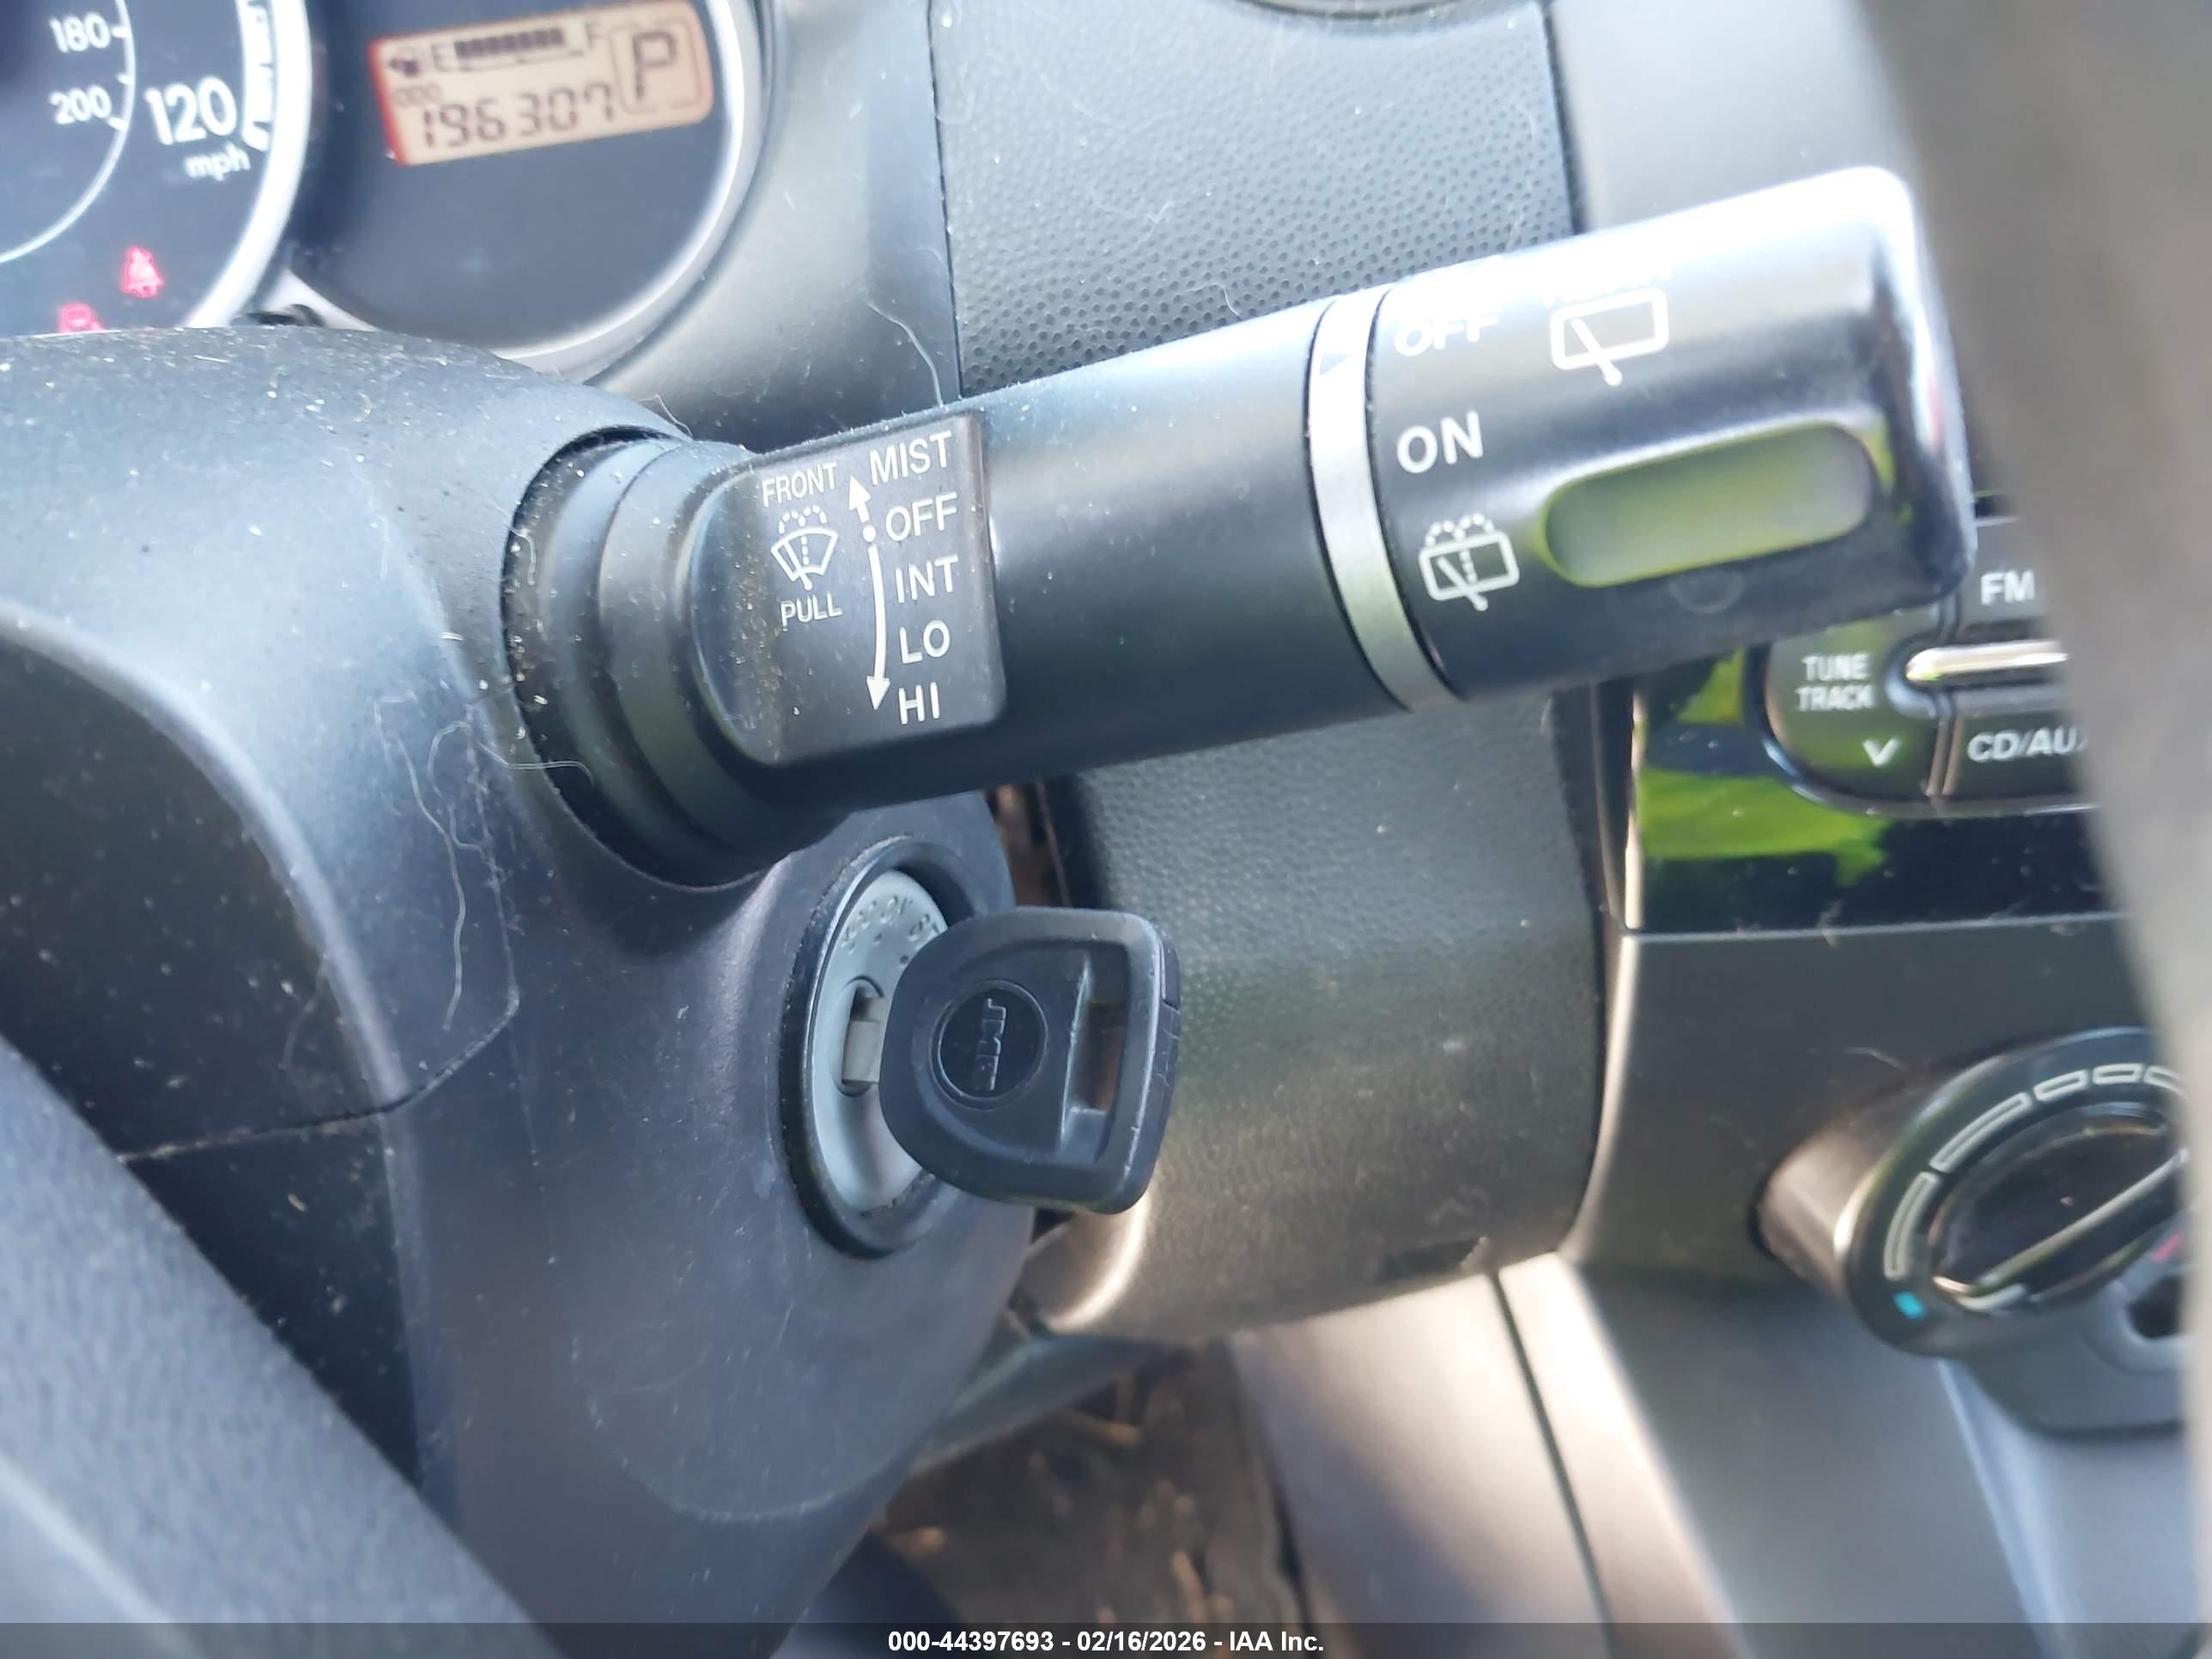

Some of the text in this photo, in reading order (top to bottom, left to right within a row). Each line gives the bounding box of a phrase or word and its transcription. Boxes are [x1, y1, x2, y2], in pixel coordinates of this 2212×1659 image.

[50, 13, 111, 53] 180
[431, 41, 453, 72] E
[632, 29, 677, 101] P
[49, 84, 112, 125] 200
[143, 76, 237, 146] 120
[422, 83, 614, 149] 196307
[184, 141, 252, 181] mph
[1393, 309, 1499, 356] OFF
[869, 430, 952, 485] MIST
[1396, 410, 1484, 474] ON
[762, 462, 838, 507] FRONT
[885, 491, 957, 542] OFF
[895, 555, 959, 604] INT
[1980, 569, 2037, 605] FM
[780, 592, 843, 631] PULL
[899, 619, 951, 665] LO
[1801, 651, 1871, 682] TUNE
[898, 681, 939, 725] HI
[1794, 684, 1875, 713] TRACK
